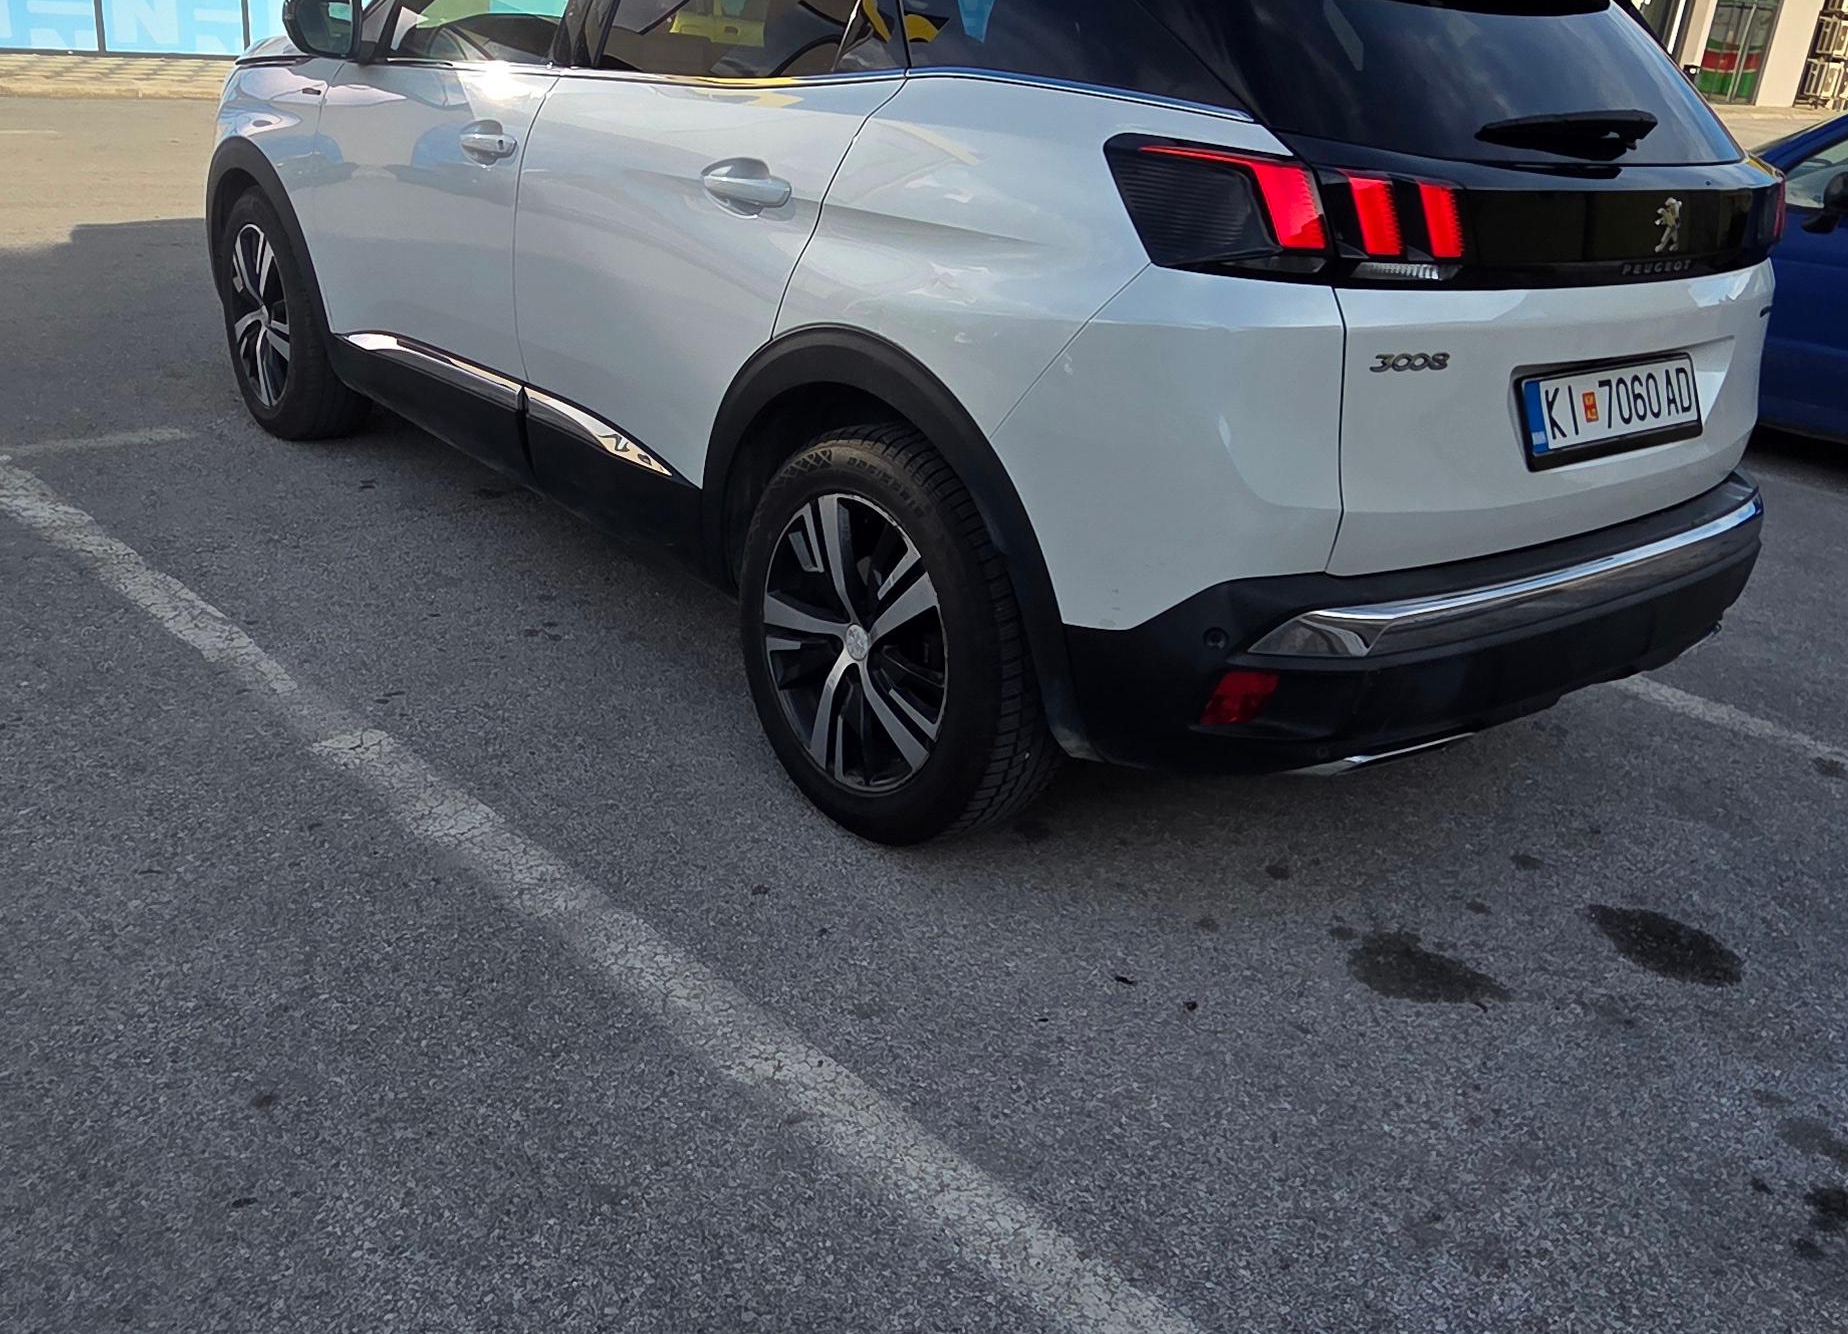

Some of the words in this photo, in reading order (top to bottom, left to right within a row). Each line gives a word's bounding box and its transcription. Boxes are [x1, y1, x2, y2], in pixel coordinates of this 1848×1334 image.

[1621, 259, 1692, 276] PEUGEOT
[1369, 352, 1450, 372] 3008
[1544, 384, 1579, 440] KI
